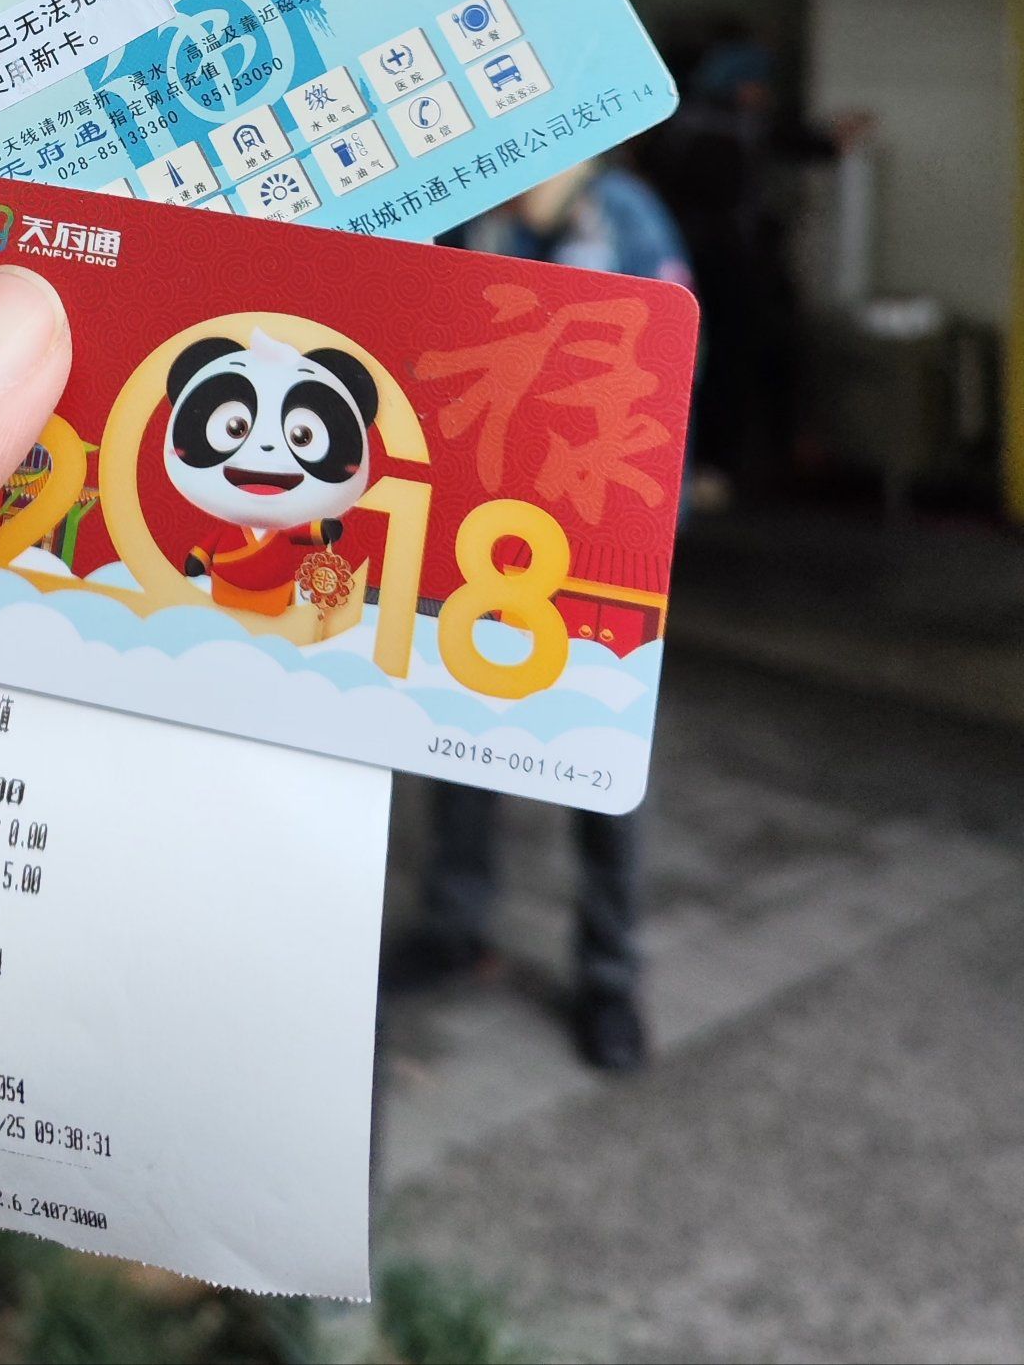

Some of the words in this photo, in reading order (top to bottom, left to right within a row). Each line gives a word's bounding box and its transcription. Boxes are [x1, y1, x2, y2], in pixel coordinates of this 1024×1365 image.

[472, 29, 501, 50] 快餐
[394, 71, 425, 92] 医院
[304, 83, 338, 112] 缴
[495, 83, 540, 110] 长途客运
[57, 110, 179, 181] 028-85133360
[200, 57, 283, 108] 85133050
[311, 104, 355, 132] 水电气
[351, 132, 369, 157] CNG
[423, 124, 453, 145] 电信
[245, 148, 274, 169] 地铁
[331, 87, 624, 236] 都城市通卡有限公司发行
[340, 160, 384, 188] 加油气
[18, 215, 122, 258] 天府通
[8, 818, 48, 851] 0.00
[2, 860, 42, 895] 5.00
[34, 1120, 112, 1157] 09:38:31
